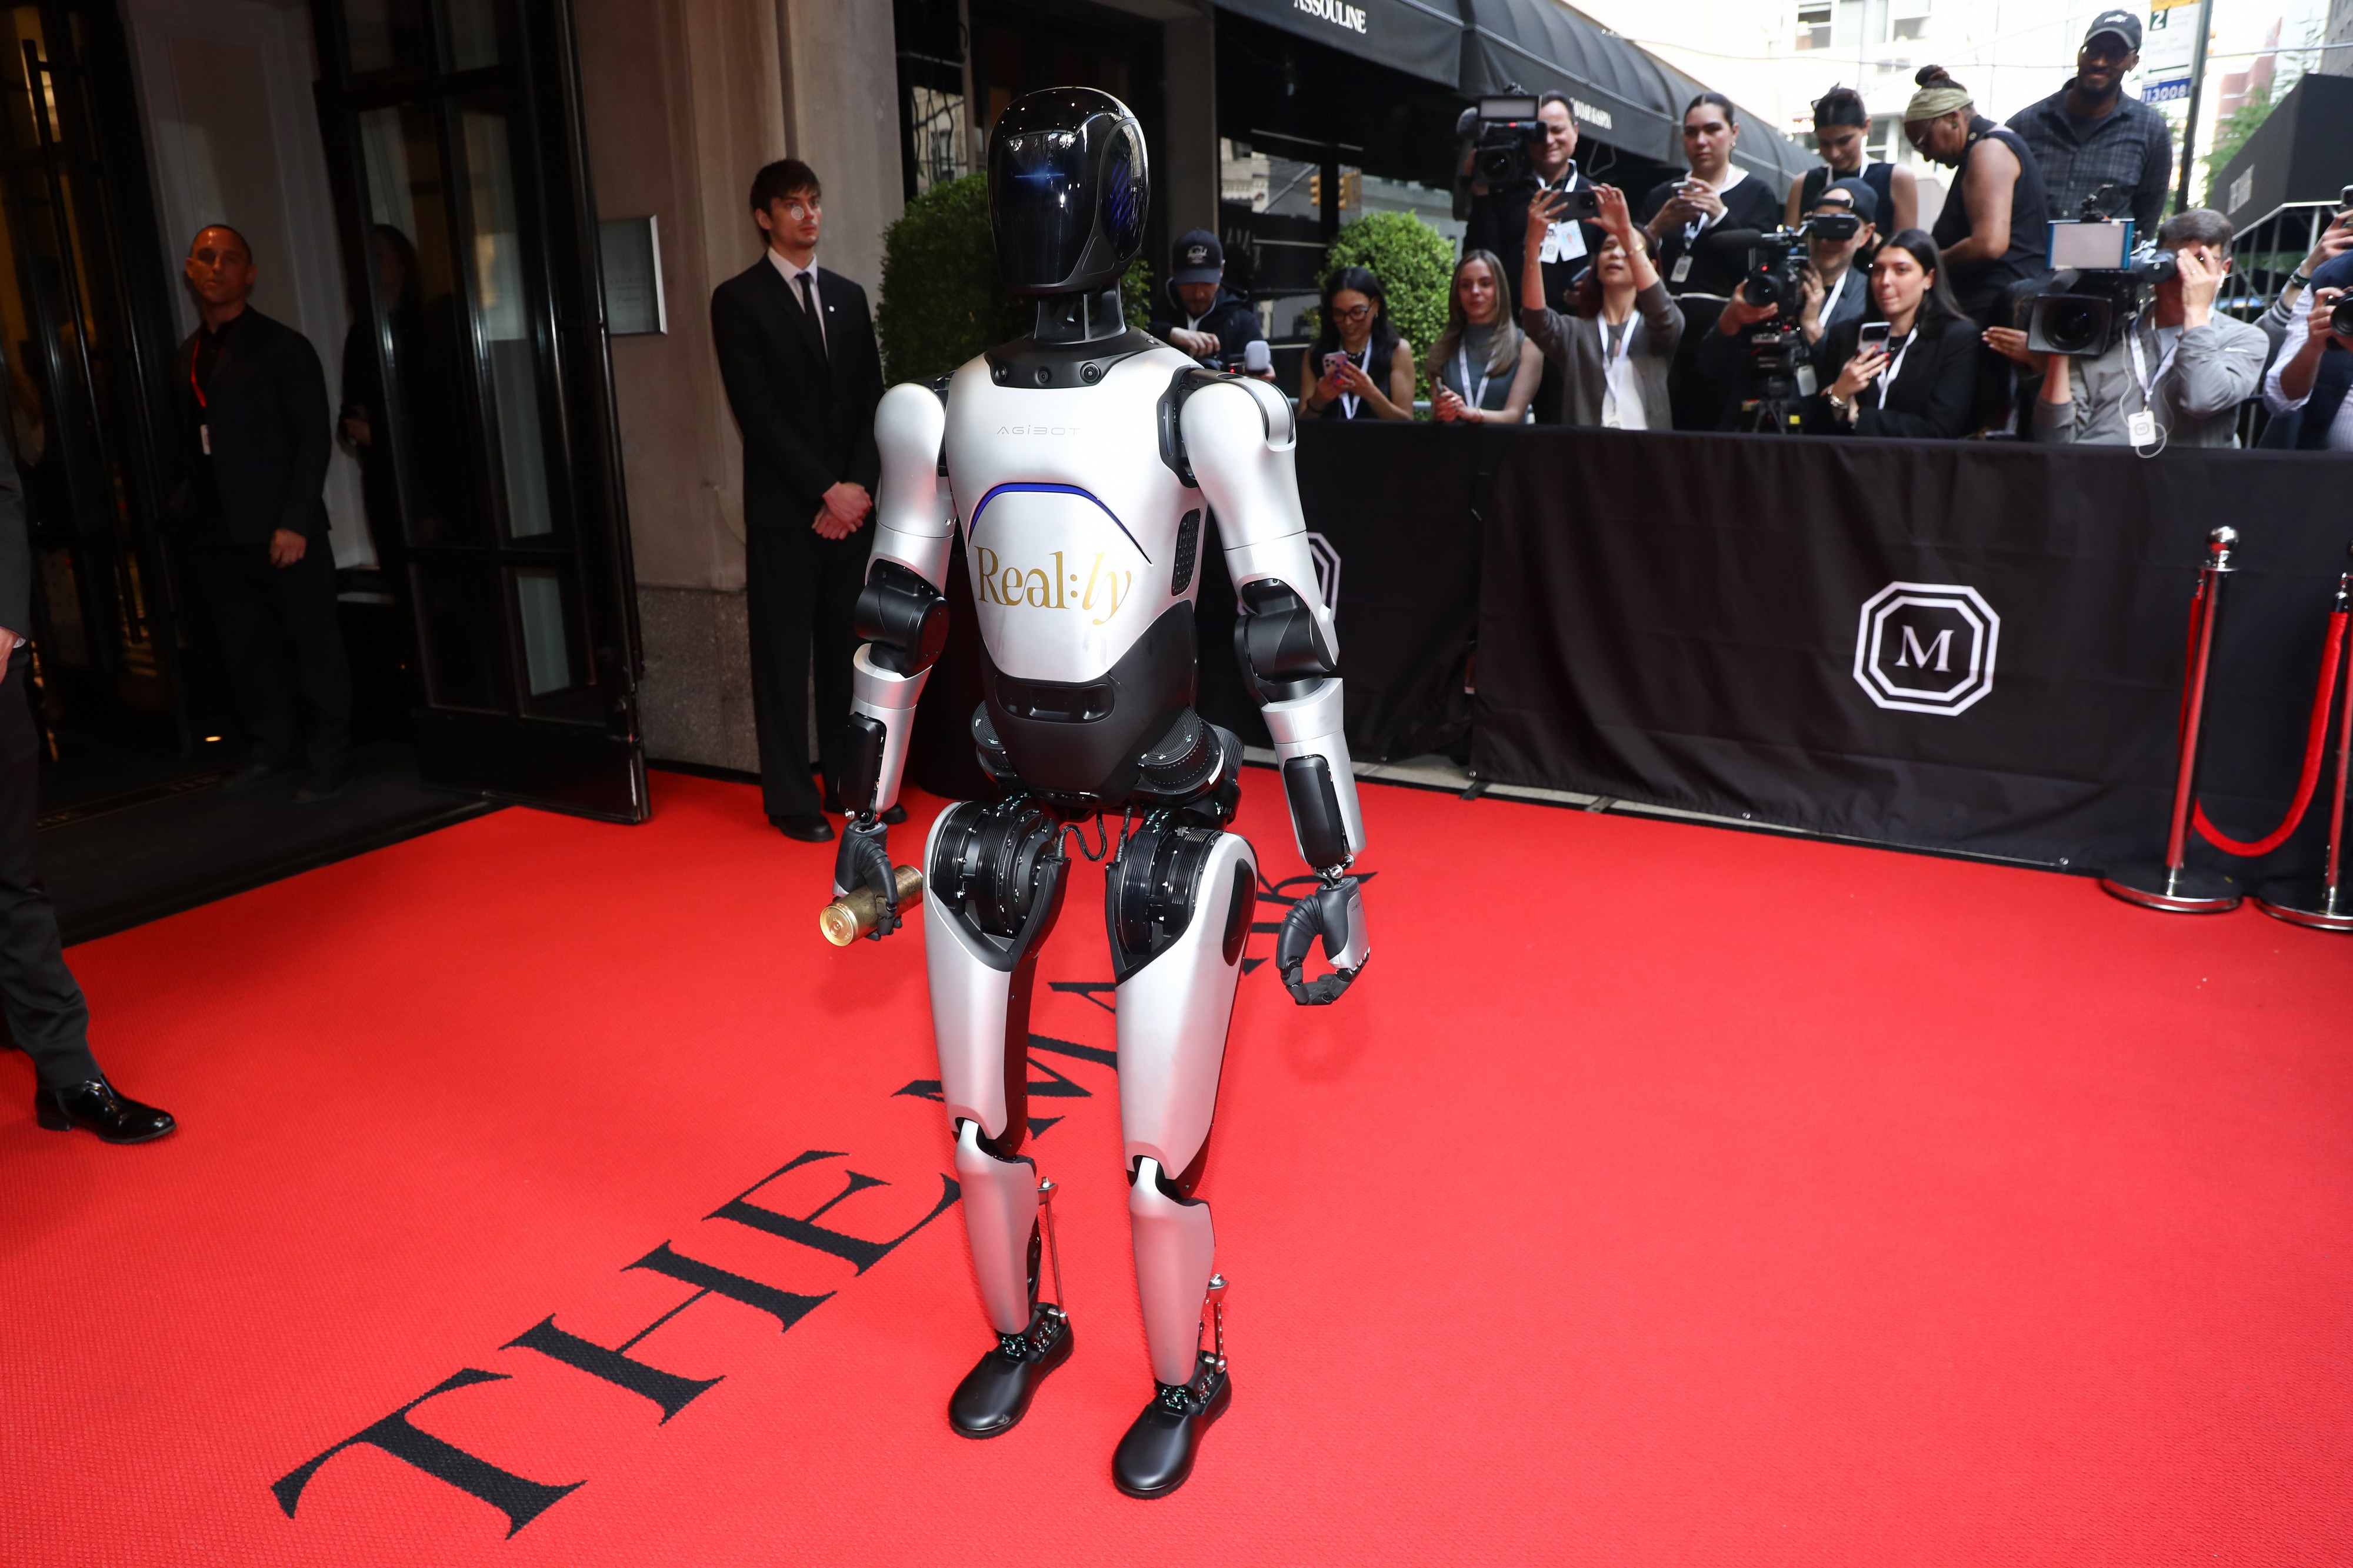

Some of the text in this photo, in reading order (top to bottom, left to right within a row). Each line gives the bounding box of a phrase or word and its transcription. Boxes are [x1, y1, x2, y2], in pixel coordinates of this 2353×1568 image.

[2151, 11, 2165, 29] 2
[1894, 625, 1955, 672] M
[271, 1150, 961, 1540] THE
